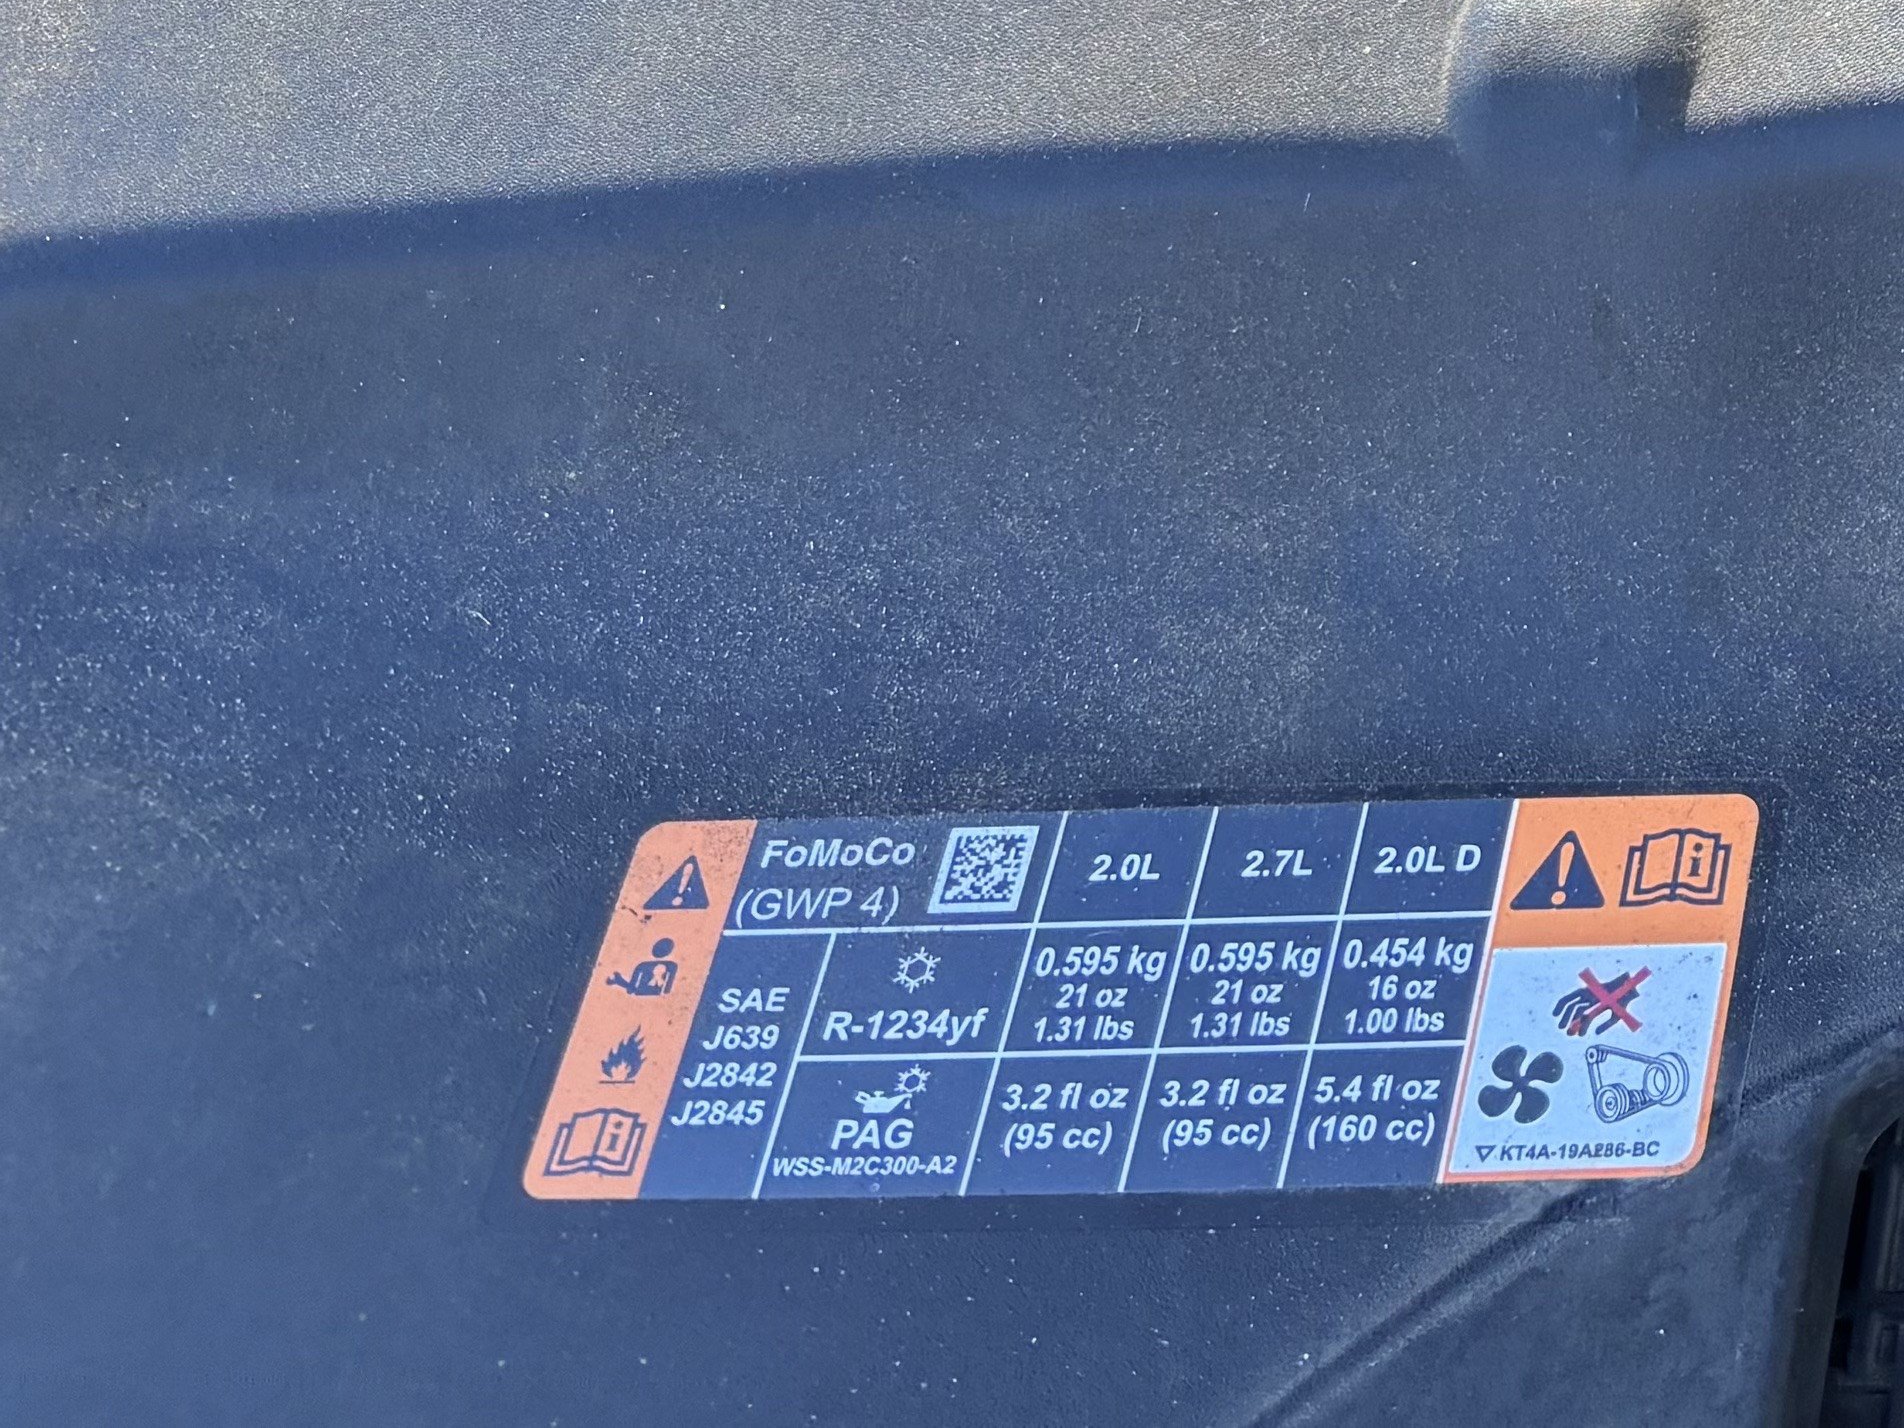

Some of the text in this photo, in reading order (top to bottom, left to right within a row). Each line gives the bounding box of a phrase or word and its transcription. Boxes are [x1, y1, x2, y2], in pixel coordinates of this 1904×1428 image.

[760, 837, 915, 868] FoMoCo
[1240, 849, 1313, 879] 2.7L
[1374, 844, 1482, 875] 2.0L D
[1088, 853, 1160, 882] 2.0L
[735, 885, 899, 928] (GWP 4)
[1035, 945, 1167, 982] 0.595 kg
[1189, 941, 1321, 979] 0.595 kg
[1342, 937, 1474, 974] 0.454 kg
[718, 987, 790, 1013] SAE
[1056, 983, 1128, 1009] 21 oz
[1211, 980, 1284, 1006] 21 oz
[1368, 976, 1438, 1001] 16 oz
[822, 1007, 989, 1046] R-1234yf
[1033, 1014, 1134, 1043] 1.31 lbs
[1189, 1011, 1291, 1039] 1.31 lbs
[1343, 1007, 1445, 1034] 1.00 lbs
[702, 1024, 780, 1051] J639
[683, 1061, 777, 1088] J2842
[1314, 1074, 1441, 1103] 5.4 fl oz
[1001, 1082, 1129, 1111] 3.2 fl oz
[1159, 1078, 1287, 1108] 3.2 fl oz
[670, 1100, 766, 1126] J2845
[830, 1118, 915, 1150] PAG
[1002, 1122, 1113, 1158] (95 cc)
[1161, 1117, 1272, 1154] (95 cc)
[1307, 1114, 1435, 1150] (160 cc)
[772, 1155, 958, 1177] WSS-M2C300-A2
